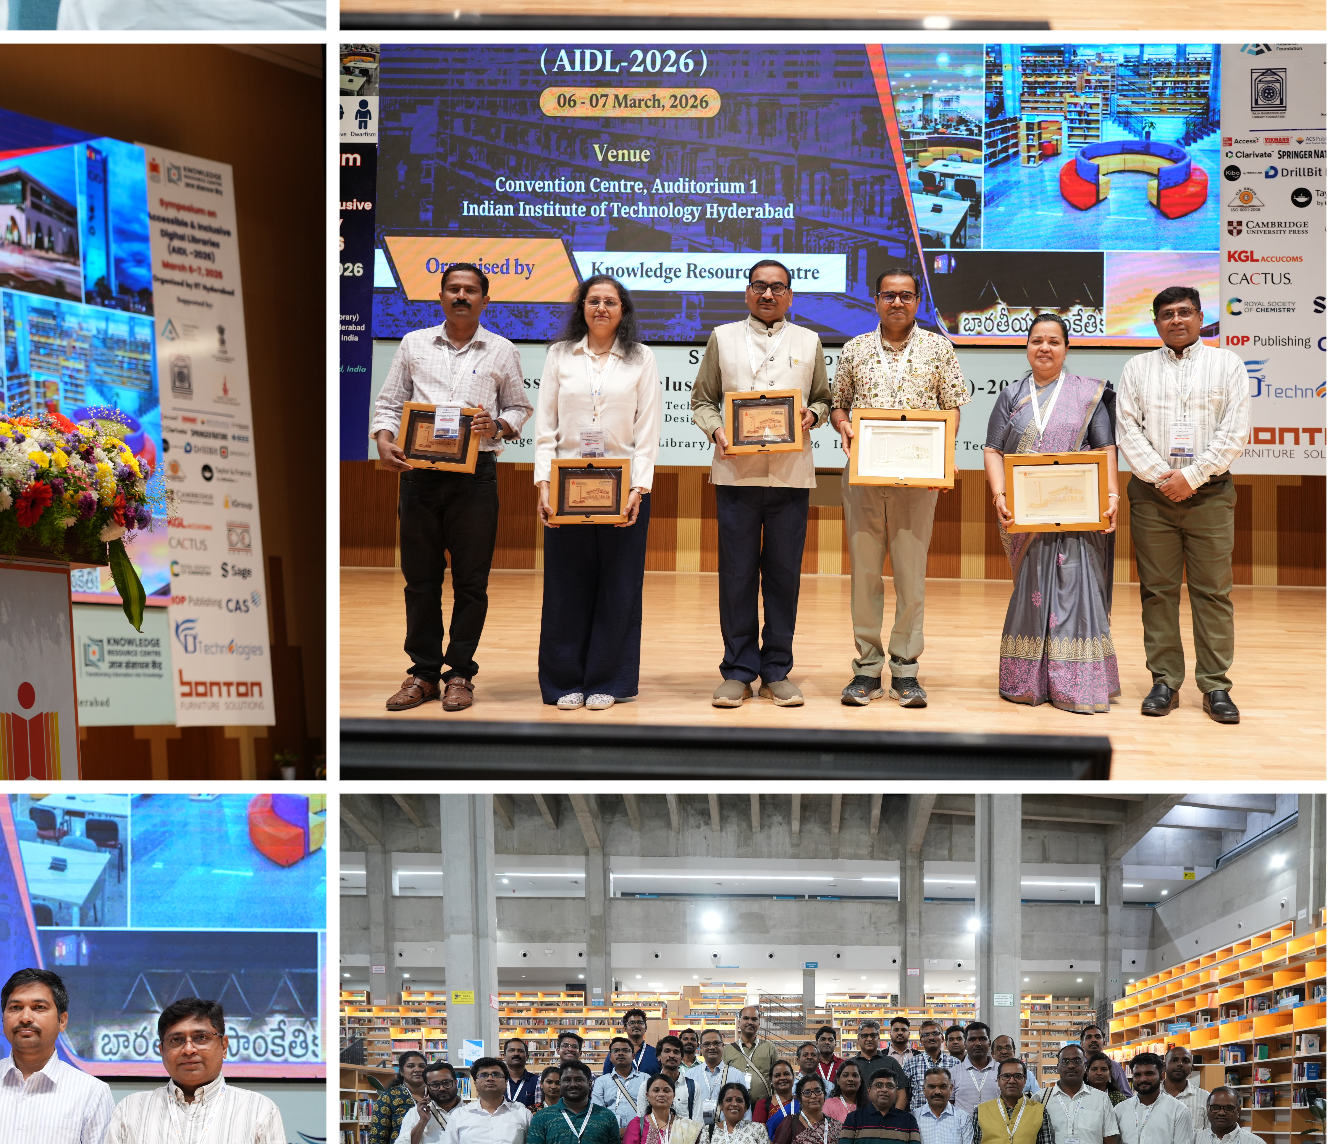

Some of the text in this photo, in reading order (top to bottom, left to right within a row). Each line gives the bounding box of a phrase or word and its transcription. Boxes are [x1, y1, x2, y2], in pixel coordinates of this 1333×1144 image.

[593, 144, 651, 162] Venue
[1281, 168, 1322, 177] DrillBit
[495, 177, 646, 196] Convention Centre,
[591, 203, 701, 222] of Technology
[1228, 251, 1259, 262] KGL
[1226, 336, 1311, 349] IOP Publishing
[231, 566, 252, 578] Sage
[226, 598, 249, 612] CAS
[107, 638, 161, 647] KNOWLEDGE
[181, 701, 264, 711] FURNITURE SOLUTIONS
